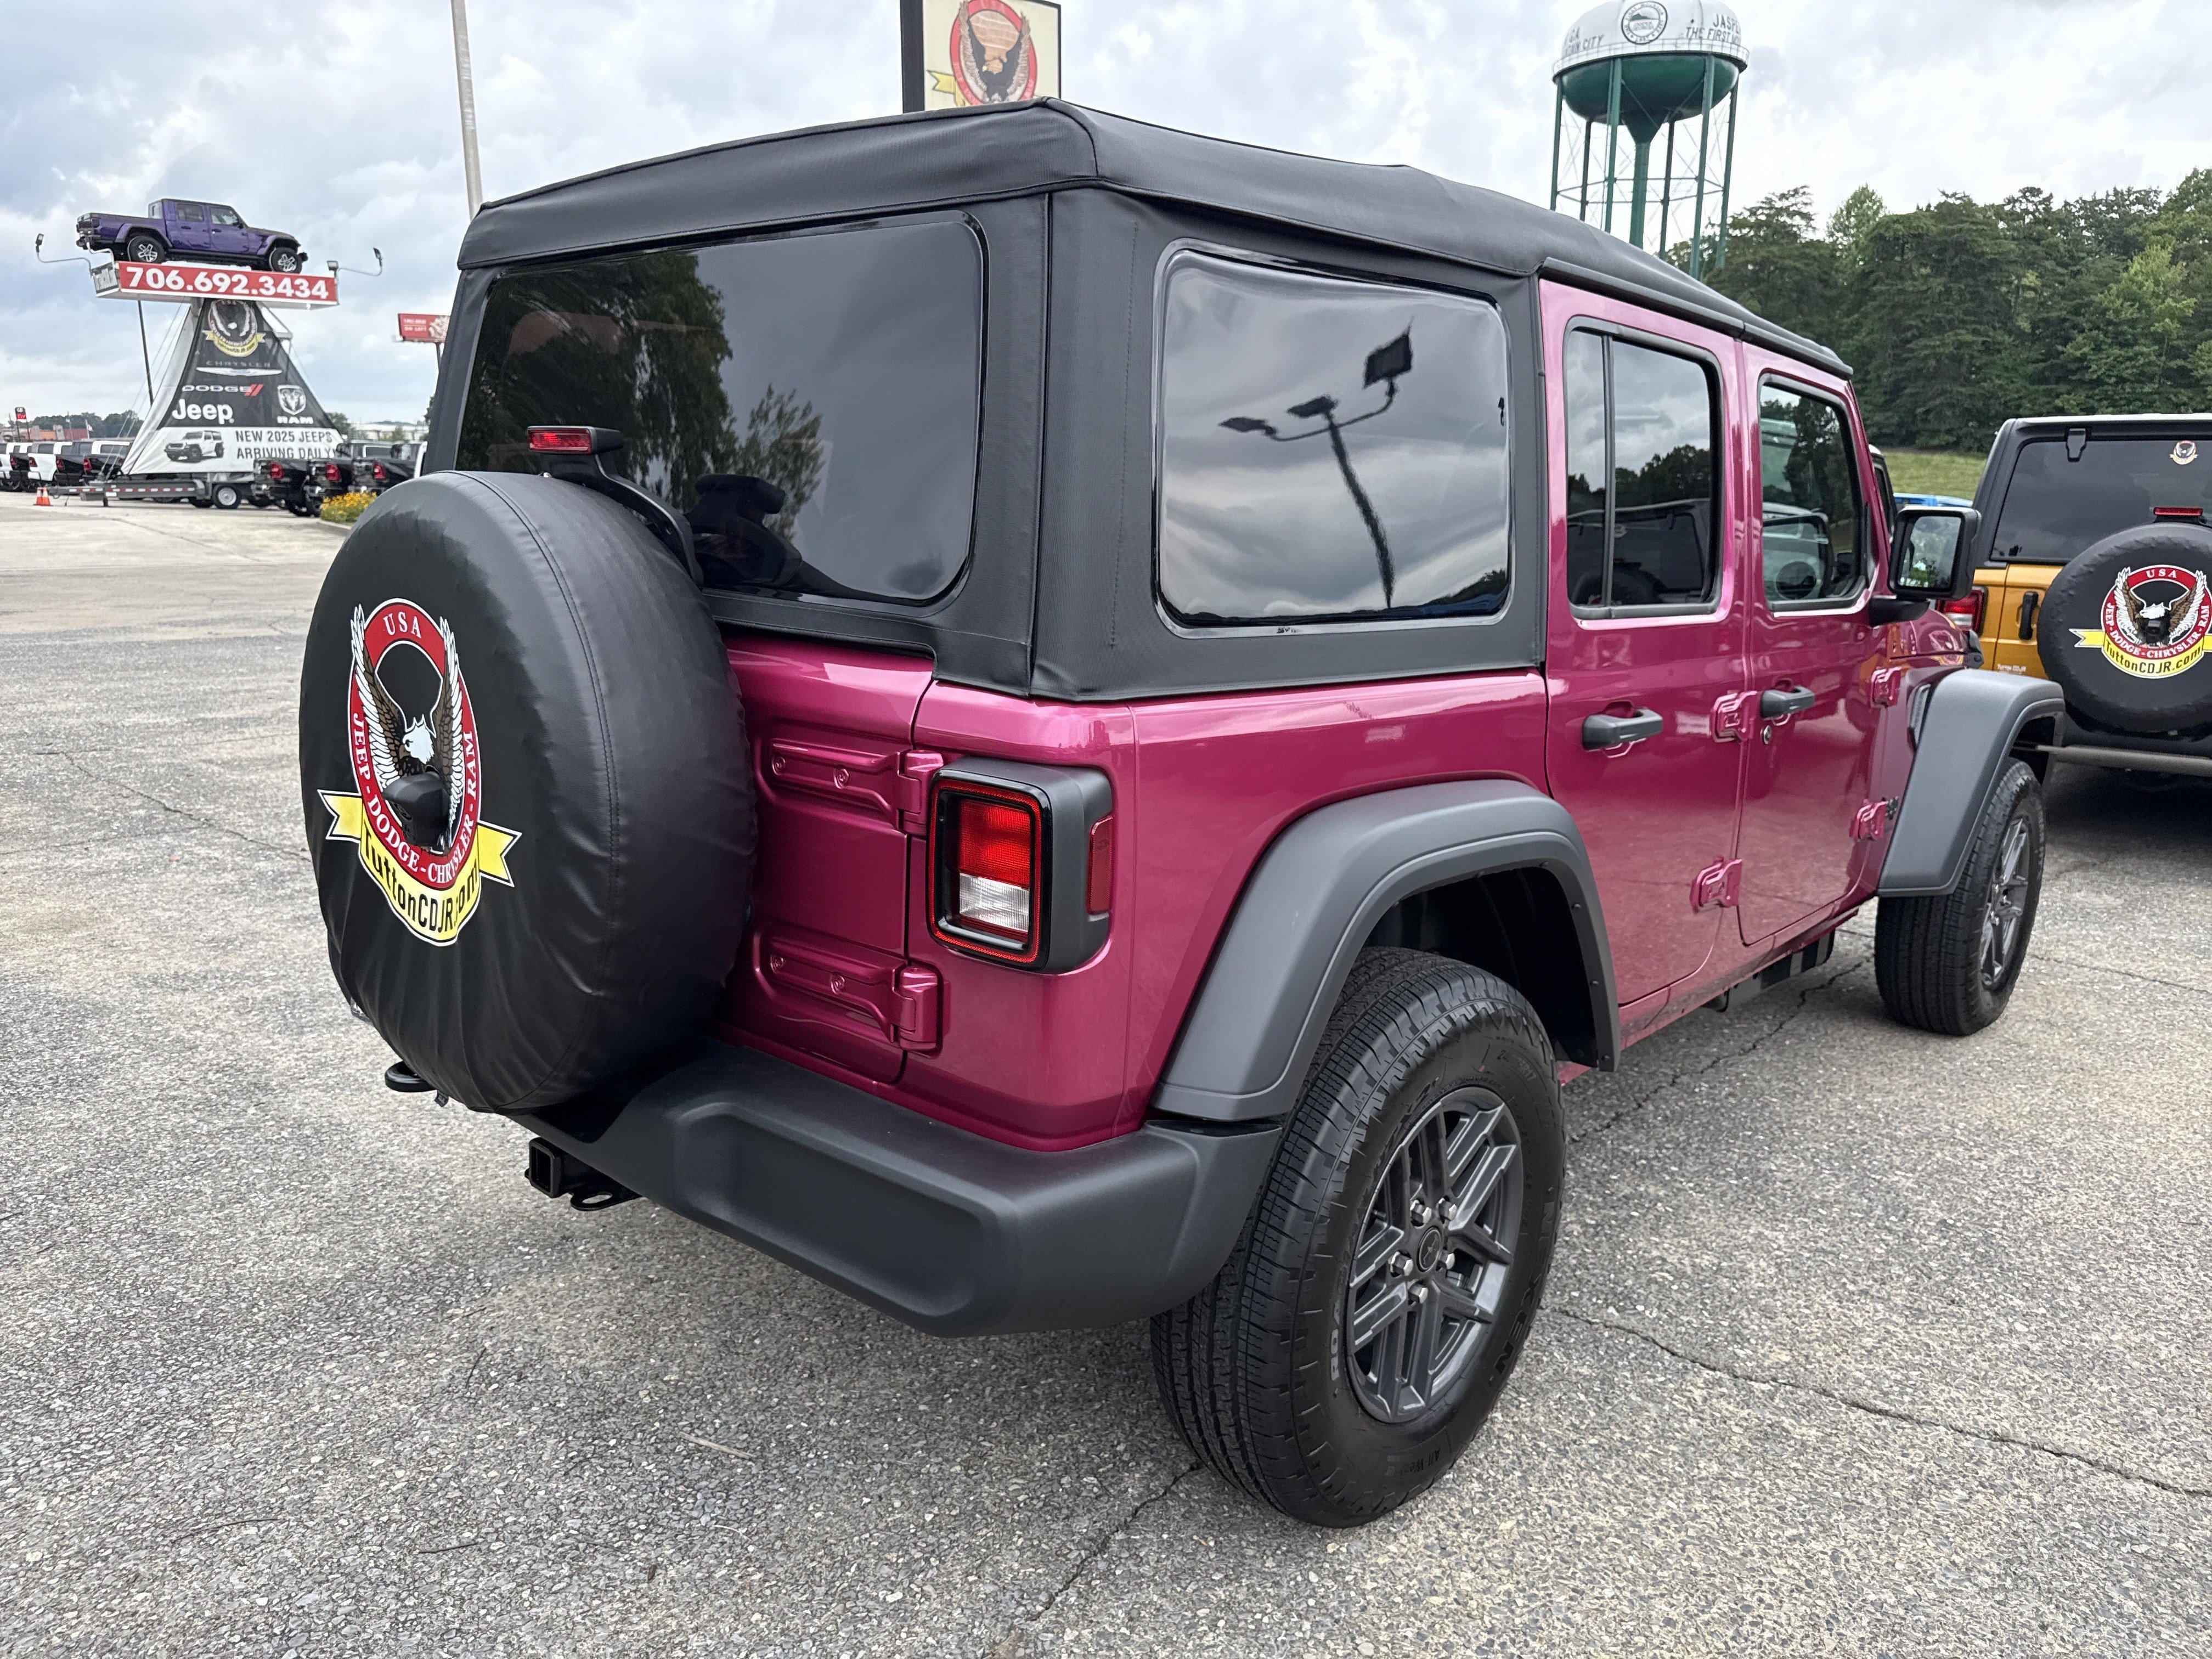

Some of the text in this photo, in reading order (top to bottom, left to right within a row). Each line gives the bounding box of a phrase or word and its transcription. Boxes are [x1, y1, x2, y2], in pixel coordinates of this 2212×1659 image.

[1582, 34, 1606, 50] CITY
[1686, 26, 1705, 38] THE
[1707, 28, 1731, 42] FIRST
[126, 266, 329, 299] 706.692.3434
[172, 398, 233, 425] Jeep
[235, 430, 332, 443] NEW 2025 JEEPS
[237, 447, 294, 459] ARRIVING
[2146, 569, 2176, 578] USA
[383, 611, 421, 639] USA
[2106, 603, 2209, 658] JEEP DODGE CHRYSLER RAM
[2106, 639, 2200, 674] TuttonCDJR.com
[354, 713, 371, 780] JEEP
[368, 794, 420, 872] DODGE
[463, 731, 476, 800] RAM
